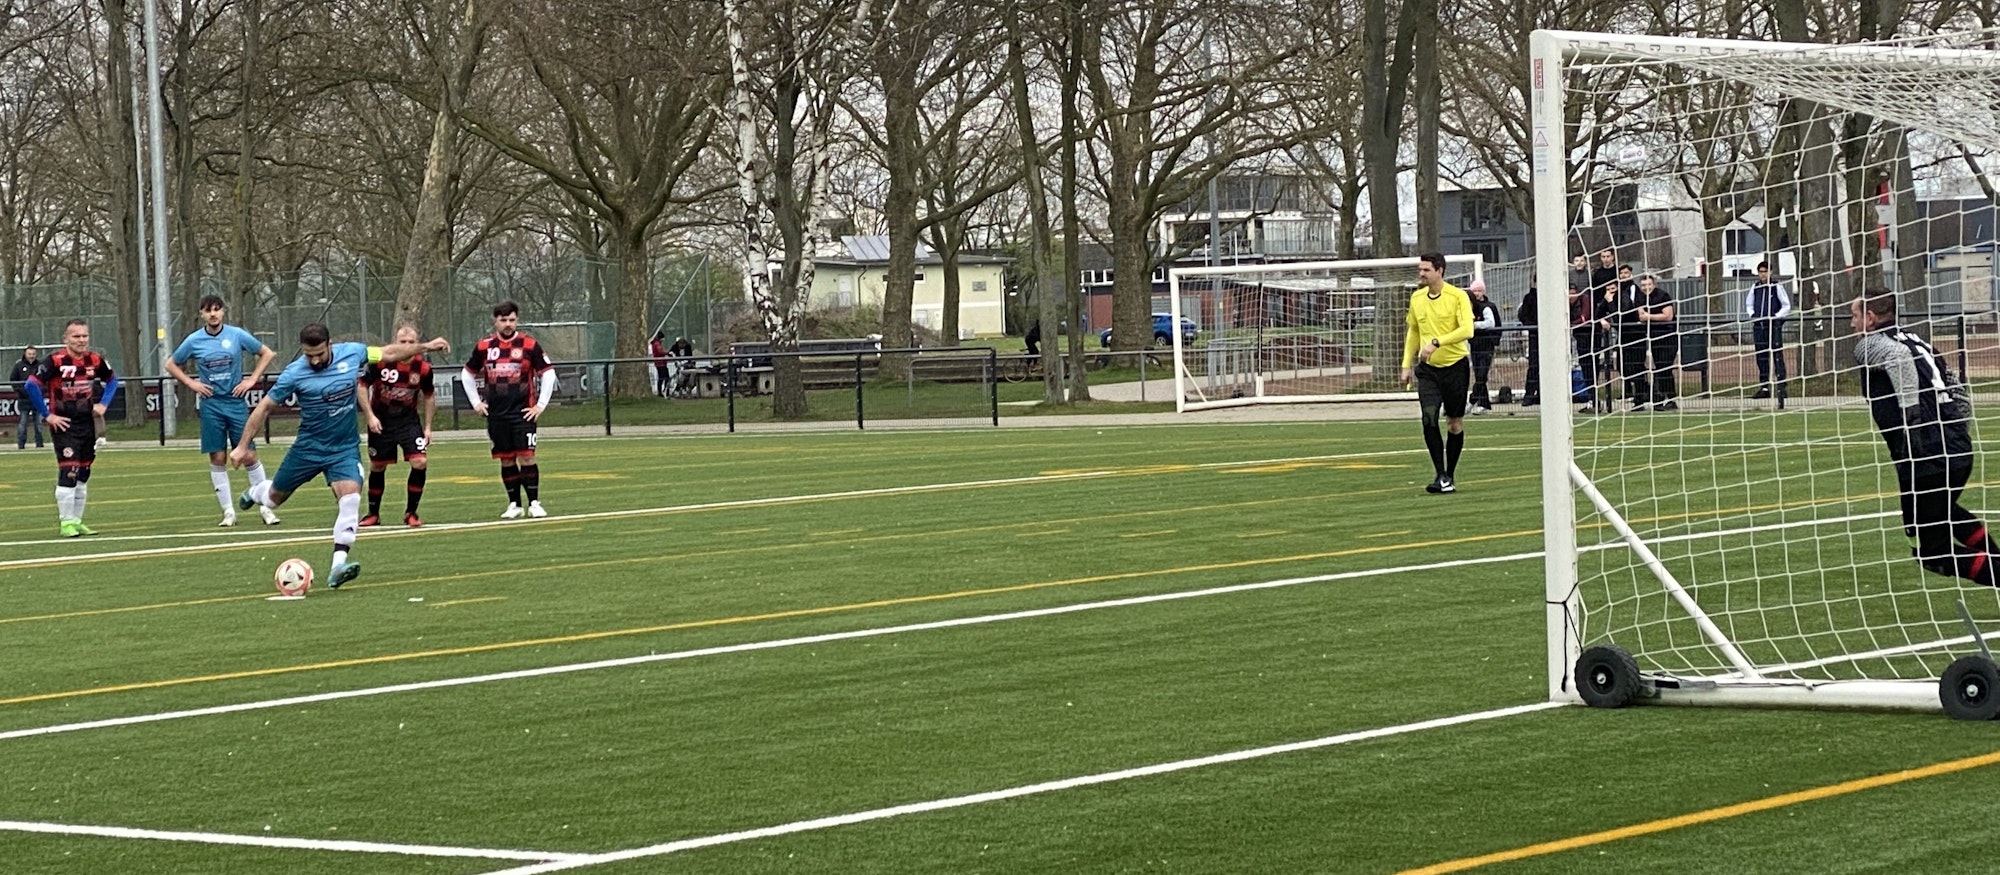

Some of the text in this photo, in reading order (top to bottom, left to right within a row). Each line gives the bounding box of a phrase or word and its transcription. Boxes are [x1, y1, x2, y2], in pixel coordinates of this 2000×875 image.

[486, 347, 500, 360] 10
[60, 365, 77, 378] 77
[380, 368, 399, 383] 99
[415, 437, 428, 450] 9
